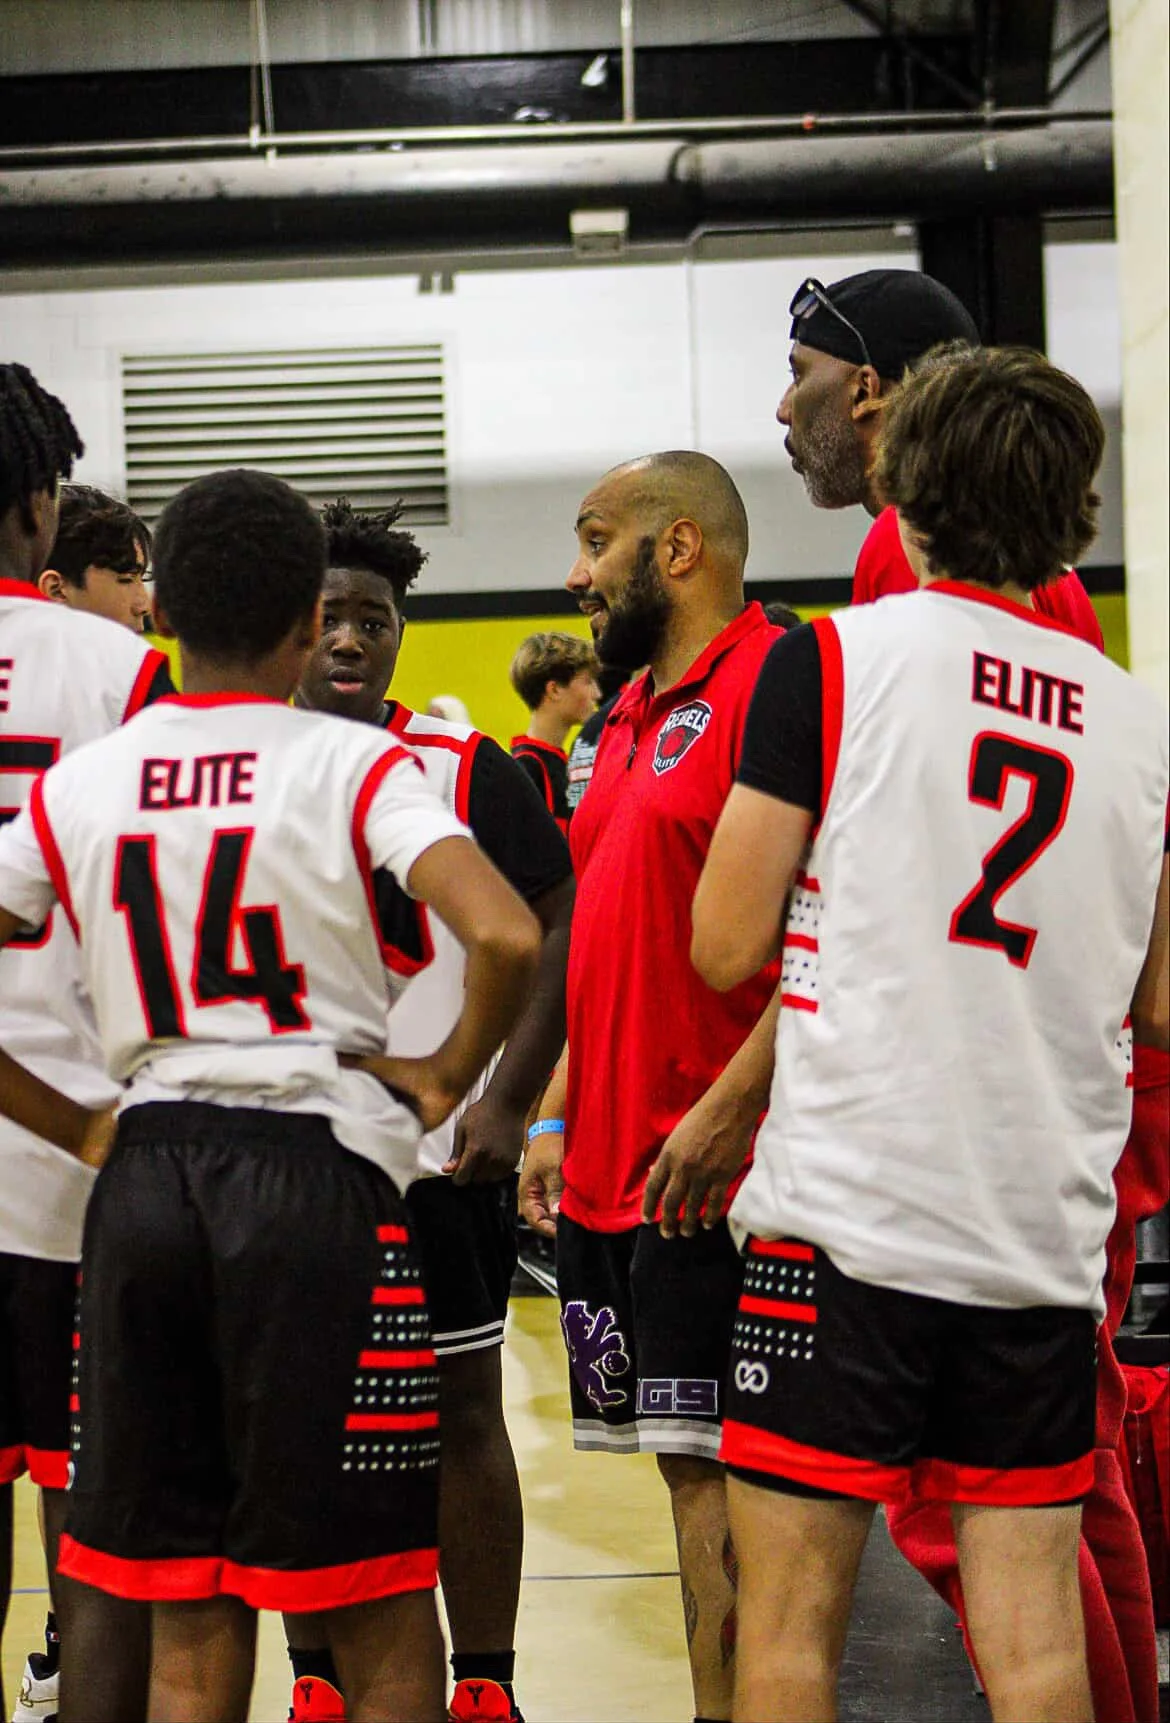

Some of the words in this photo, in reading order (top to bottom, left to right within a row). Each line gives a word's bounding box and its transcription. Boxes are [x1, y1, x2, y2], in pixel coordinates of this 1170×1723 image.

[971, 650, 1084, 736] ELITE
[138, 751, 258, 811] ELITE
[948, 730, 1074, 970] 2
[113, 826, 312, 1039] 14
[636, 1378, 718, 1415] GS
